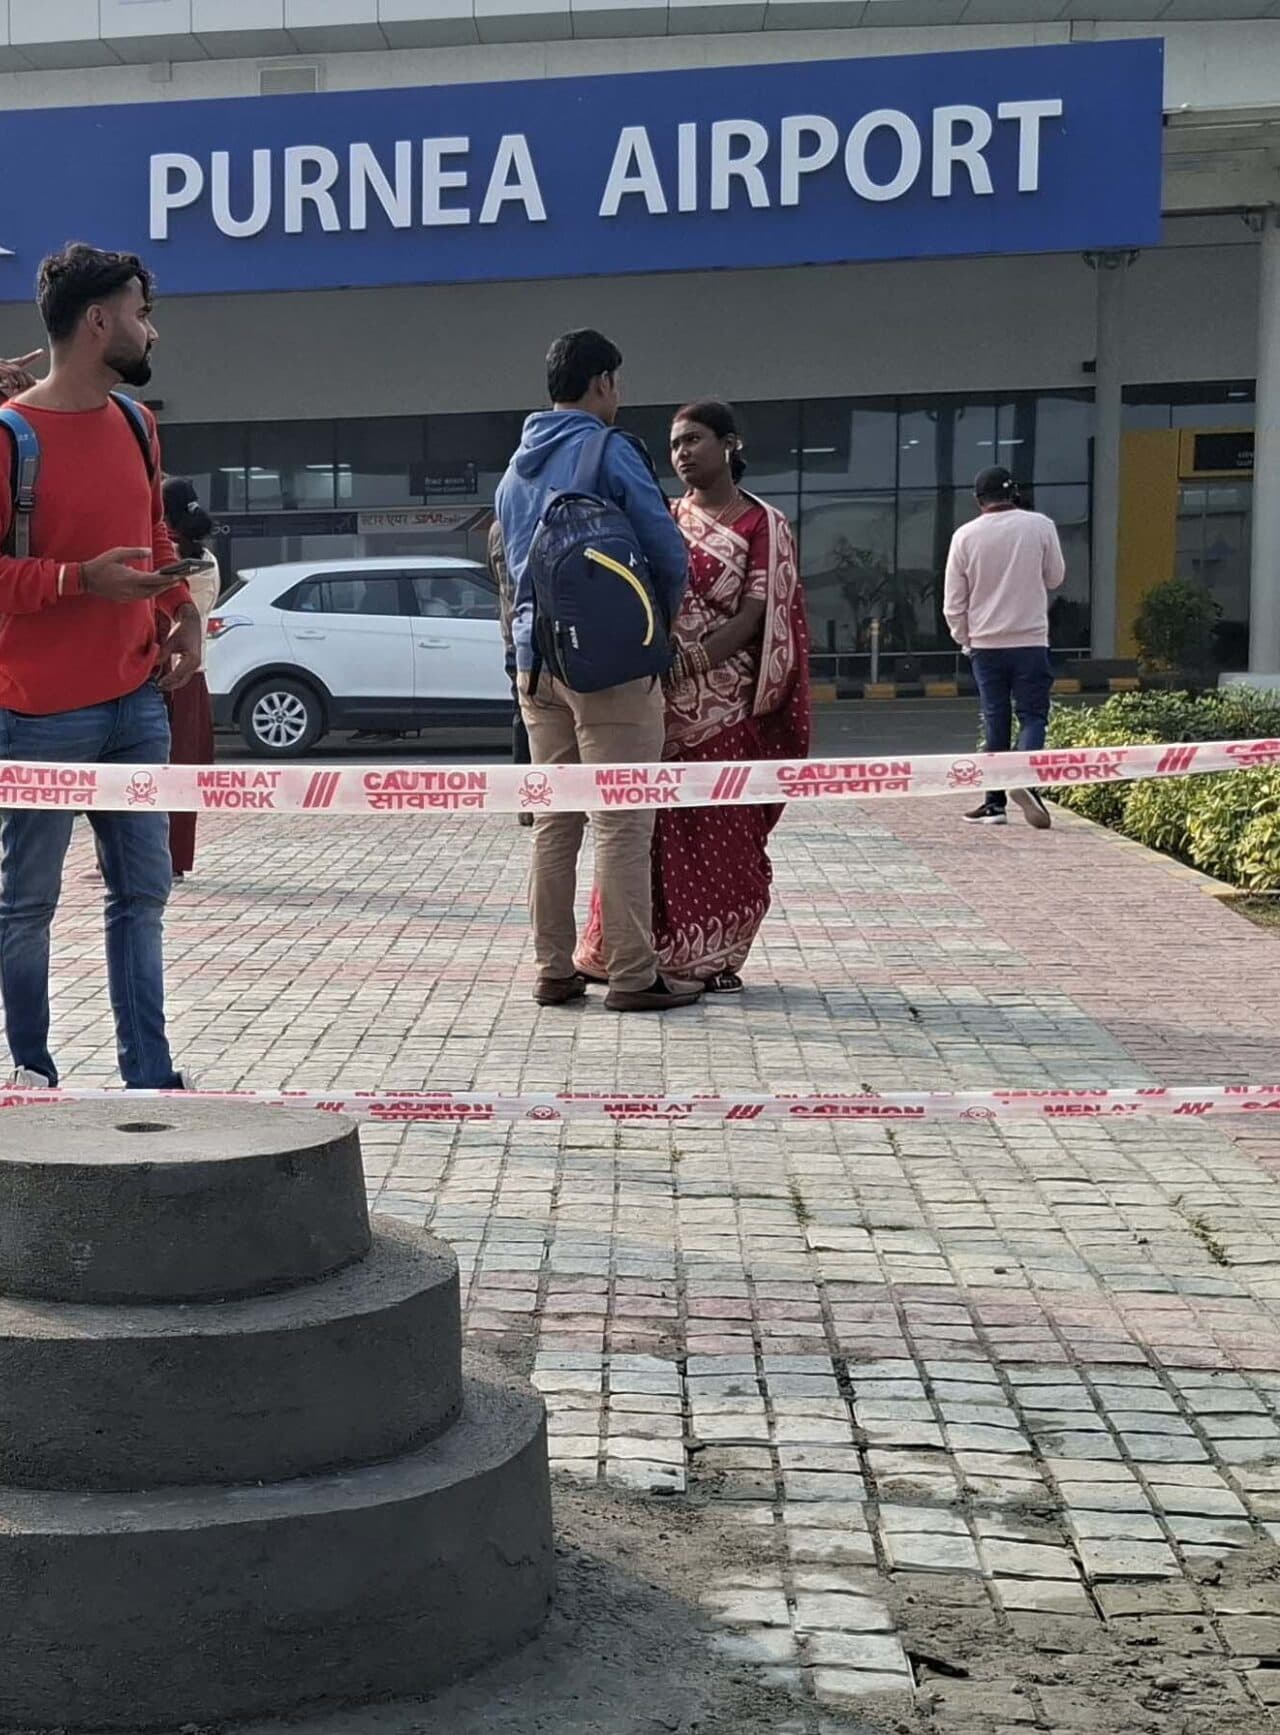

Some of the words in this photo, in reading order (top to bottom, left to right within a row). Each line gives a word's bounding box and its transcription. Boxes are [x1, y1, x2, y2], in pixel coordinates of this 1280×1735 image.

[149, 134, 547, 240] PURNEA
[599, 98, 1063, 217] AIRPORT
[1096, 749, 1129, 763] AT
[197, 771, 246, 789] MEN
[253, 771, 282, 788] AT
[364, 771, 488, 791] CAUTION
[595, 768, 648, 786] MEN
[654, 767, 687, 785] AT
[776, 762, 912, 781] CAUTION
[1036, 763, 1124, 782] WORK
[601, 787, 682, 806] WORK
[778, 777, 915, 798] सावधान
[201, 789, 276, 808] WORK
[366, 792, 489, 810] सावधान
[603, 1103, 658, 1113] MEN
[665, 1103, 698, 1113] AT
